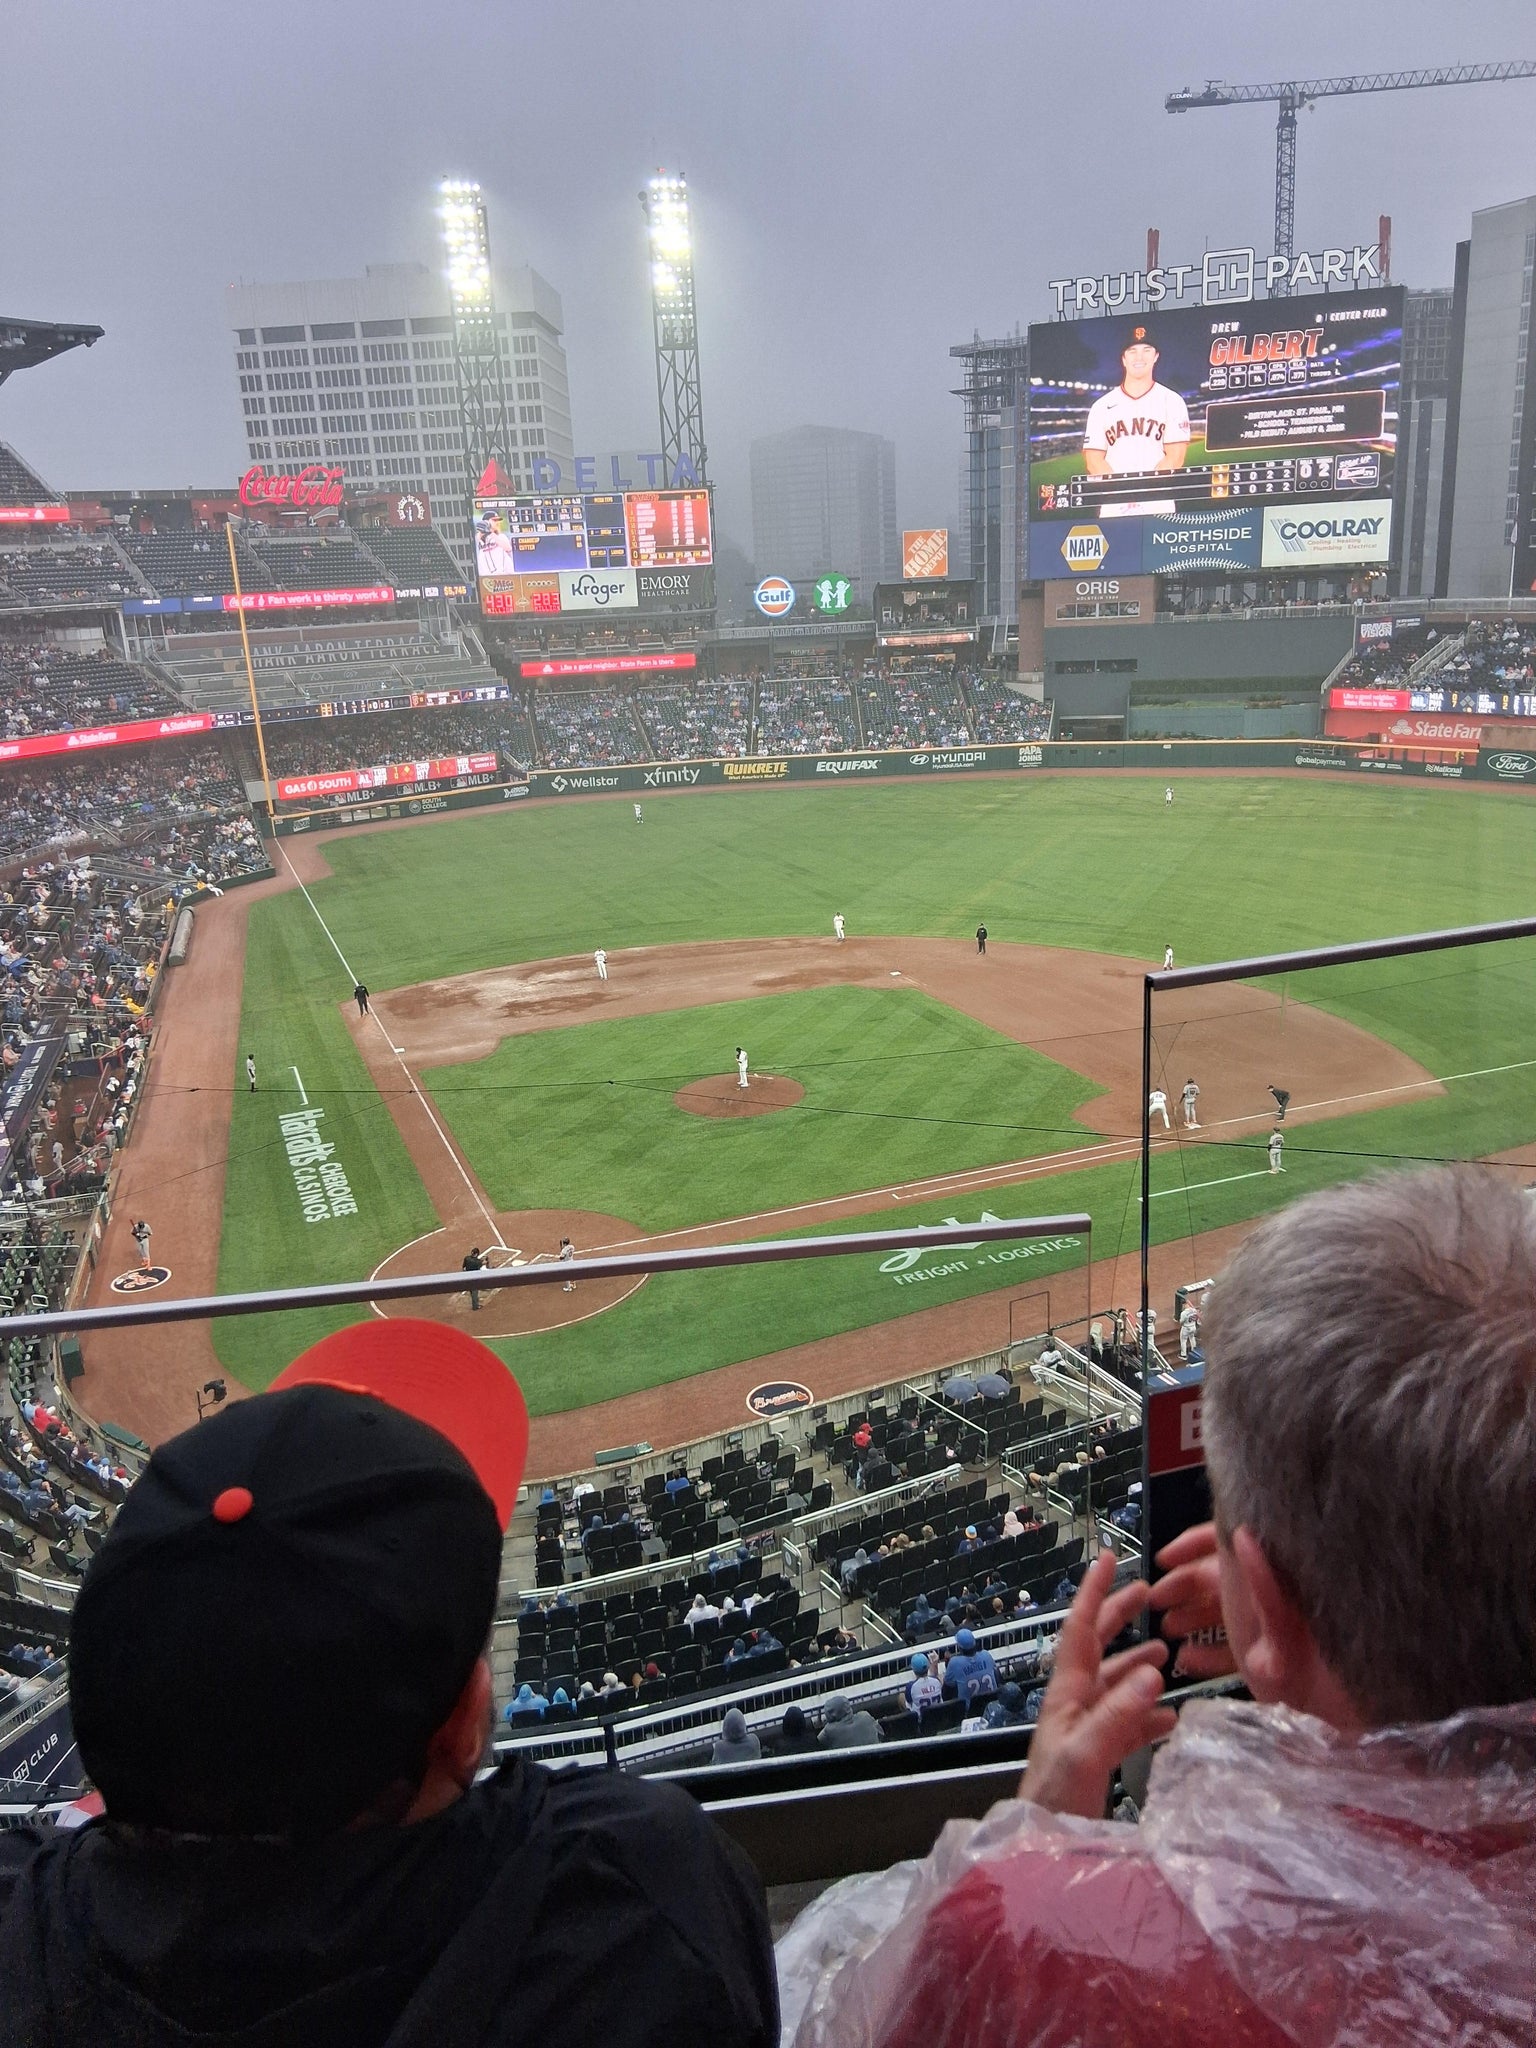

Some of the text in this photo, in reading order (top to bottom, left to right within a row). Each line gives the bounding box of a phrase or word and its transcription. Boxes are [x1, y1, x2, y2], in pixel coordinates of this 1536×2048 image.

[1049, 244, 1382, 312] TRUIST PARK
[1363, 308, 1388, 319] FIELD
[1211, 321, 1240, 334] DREW
[1210, 328, 1324, 366] GILBERT
[1105, 417, 1166, 446] GIANTS
[531, 452, 700, 491] DELTA
[1234, 472, 1240, 482] 3
[1250, 472, 1257, 480] 0
[1266, 470, 1273, 479] 2
[1284, 469, 1290, 478] 2
[1300, 465, 1312, 478] 0
[1319, 464, 1330, 478] 2
[239, 465, 347, 506] Coca-Cola
[1076, 484, 1082, 494] 1
[1233, 486, 1240, 494] 3
[1250, 484, 1256, 493] 0
[1266, 483, 1273, 492] 2
[1283, 482, 1290, 491] 2
[1076, 497, 1082, 506] 2
[1153, 527, 1252, 545] NORTHSIDE
[1280, 517, 1384, 540] COOLRAY
[908, 535, 925, 554] THE
[1068, 539, 1101, 558] NAPA
[1170, 543, 1233, 554] HOSPITAL
[902, 530, 948, 577] HOME
[920, 544, 948, 577] DEPOT
[571, 574, 626, 605] Kroger
[640, 575, 691, 590] EMORY
[1076, 580, 1120, 596] ORIS
[268, 589, 378, 605] Fan work is thirsty work
[486, 592, 560, 608] 430 283
[641, 589, 690, 597] HEALTHCARE
[757, 591, 792, 603] Gulf
[1361, 622, 1392, 630] BRAVES
[1361, 629, 1392, 638] VISION
[294, 640, 361, 664] AARON
[354, 636, 441, 661] TERRACE
[578, 664, 593, 672] good
[1430, 692, 1444, 701] MIA
[932, 752, 986, 763] HYUNDAI
[1019, 746, 1042, 756] PAPA
[724, 762, 788, 776] QUIKRETE
[816, 760, 879, 774] EQUIFAX
[1433, 766, 1463, 774] National
[1496, 755, 1530, 770] Ford
[358, 774, 372, 785] AL
[468, 774, 494, 786] MLB+
[570, 776, 619, 788] Wellstar
[644, 766, 700, 787] xfinity
[284, 777, 352, 795] GAS SOUTH
[347, 790, 376, 803] MLB+
[422, 802, 448, 810] COLLEGE
[278, 1107, 336, 1167] Harrah's
[293, 1167, 331, 1223] CASINOS
[318, 1162, 359, 1217] CHEROKEE
[893, 1260, 970, 1286] FREIGHT
[988, 1237, 1082, 1264] LOGISTICS
[754, 1390, 796, 1410] Braves
[968, 1674, 994, 1697] 23
[29, 1733, 59, 1768] CLUB
